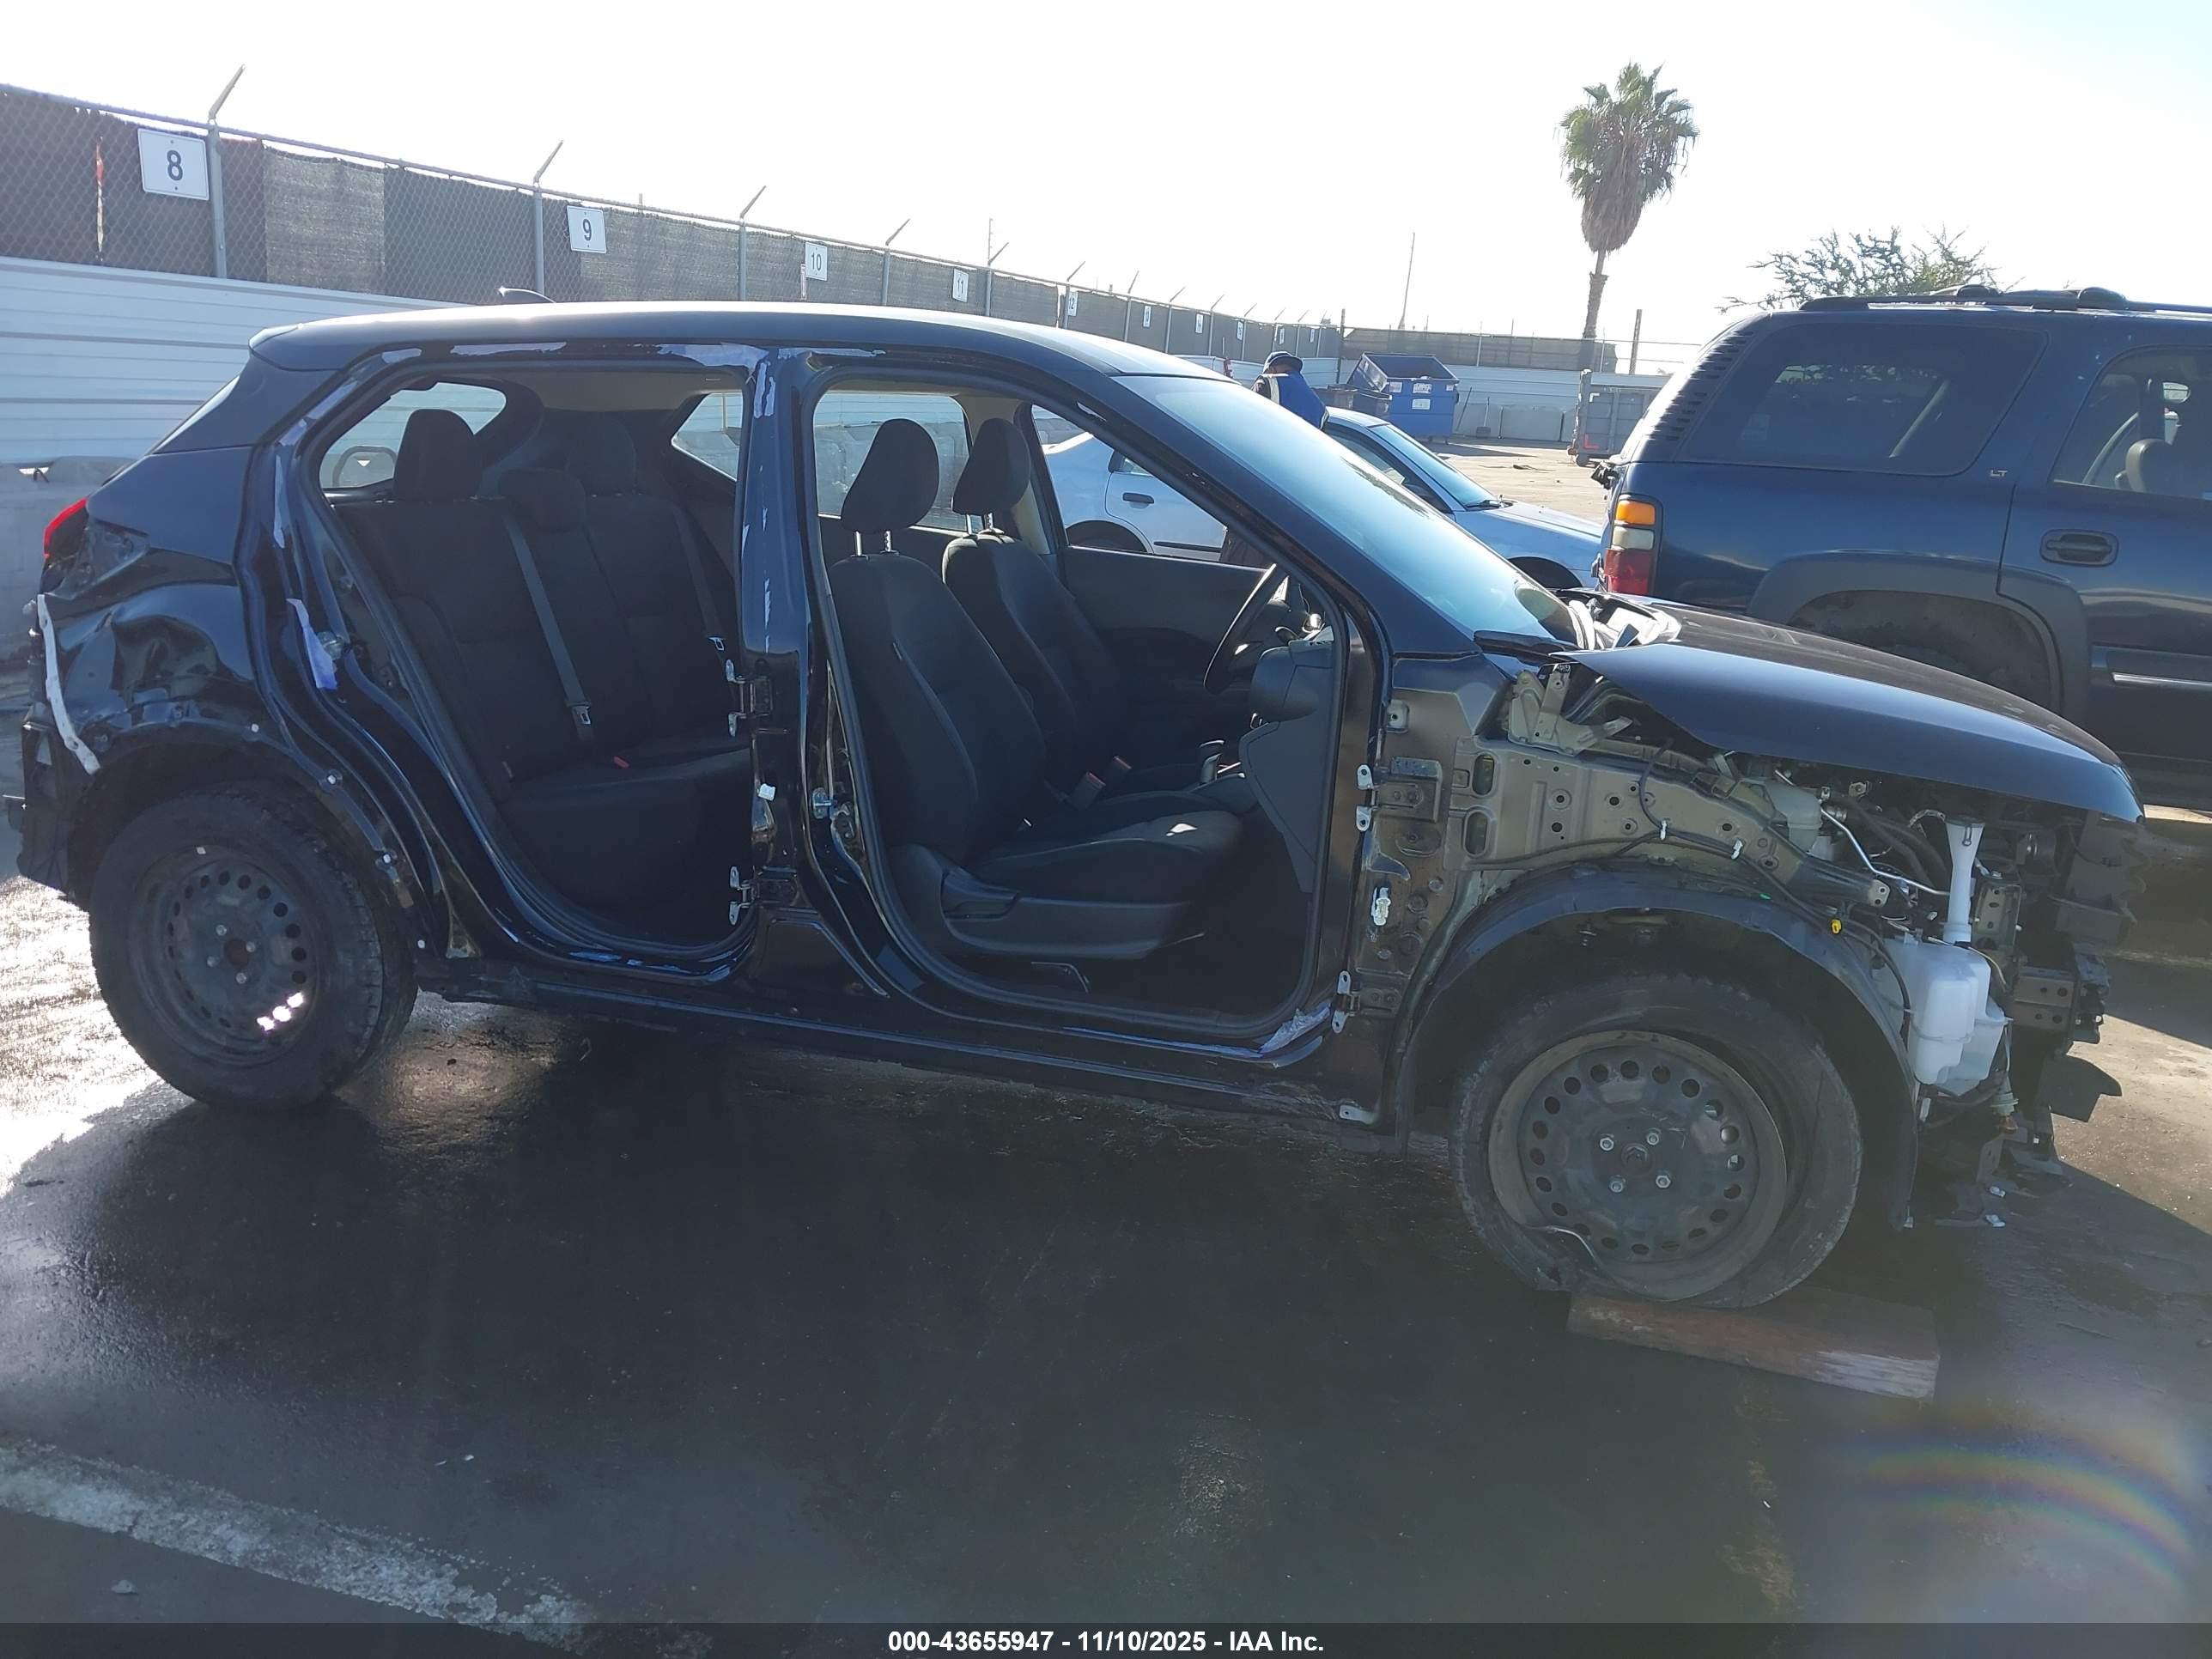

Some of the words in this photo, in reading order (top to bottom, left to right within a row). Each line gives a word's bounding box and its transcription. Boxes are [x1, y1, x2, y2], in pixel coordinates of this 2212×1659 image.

[167, 149, 183, 181] 8
[582, 218, 592, 241] 9
[811, 252, 822, 271] 10
[957, 278, 964, 294] 11
